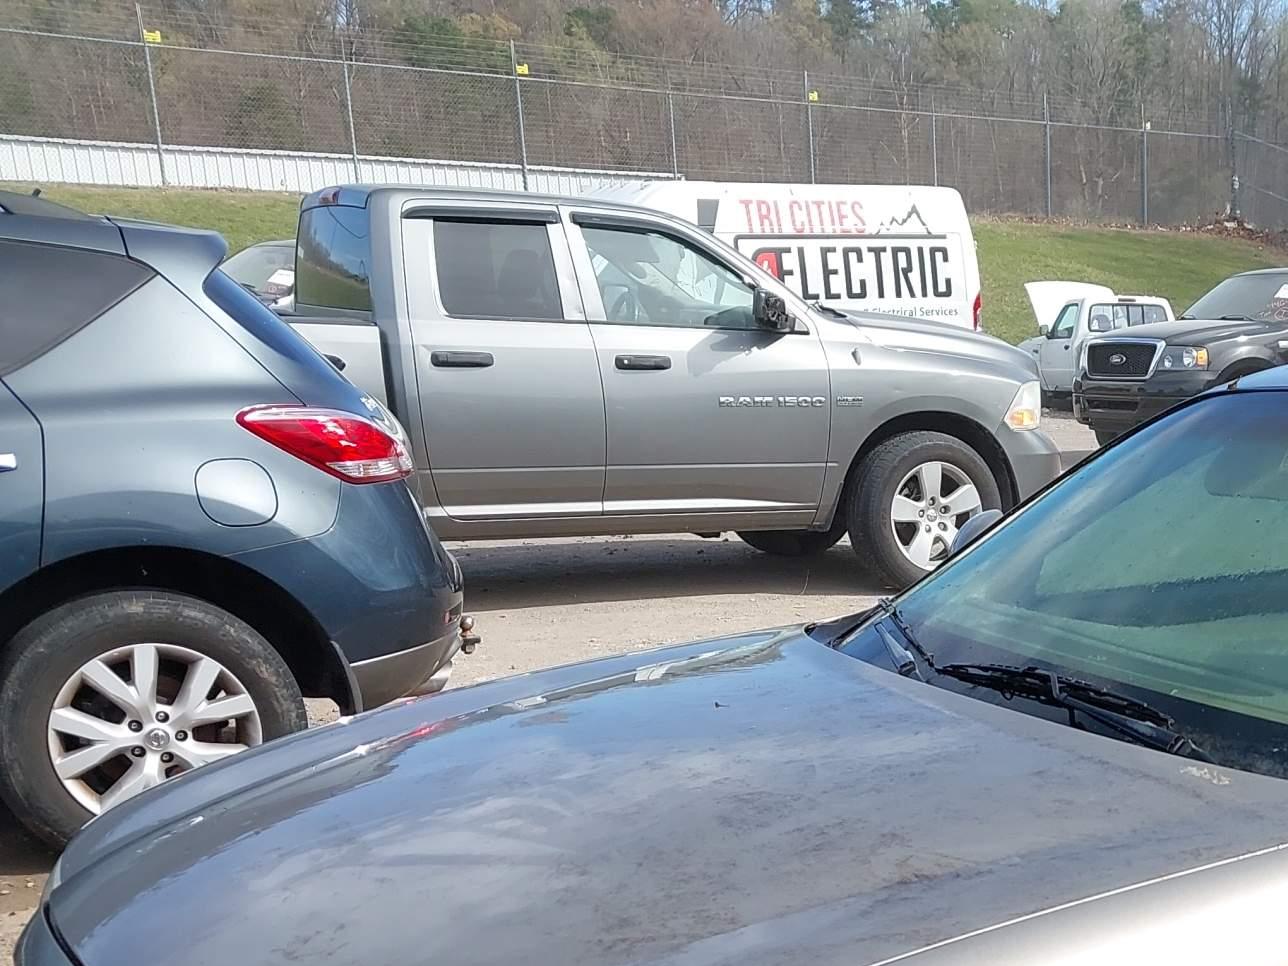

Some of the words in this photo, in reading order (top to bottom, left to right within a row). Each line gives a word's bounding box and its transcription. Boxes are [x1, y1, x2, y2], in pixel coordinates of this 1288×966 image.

[739, 199, 783, 233] TRI
[789, 200, 867, 233] CITIES
[752, 246, 952, 299] ELECTRIC
[920, 307, 959, 317] Services
[719, 396, 774, 408] RAM
[777, 396, 826, 408] 1500
